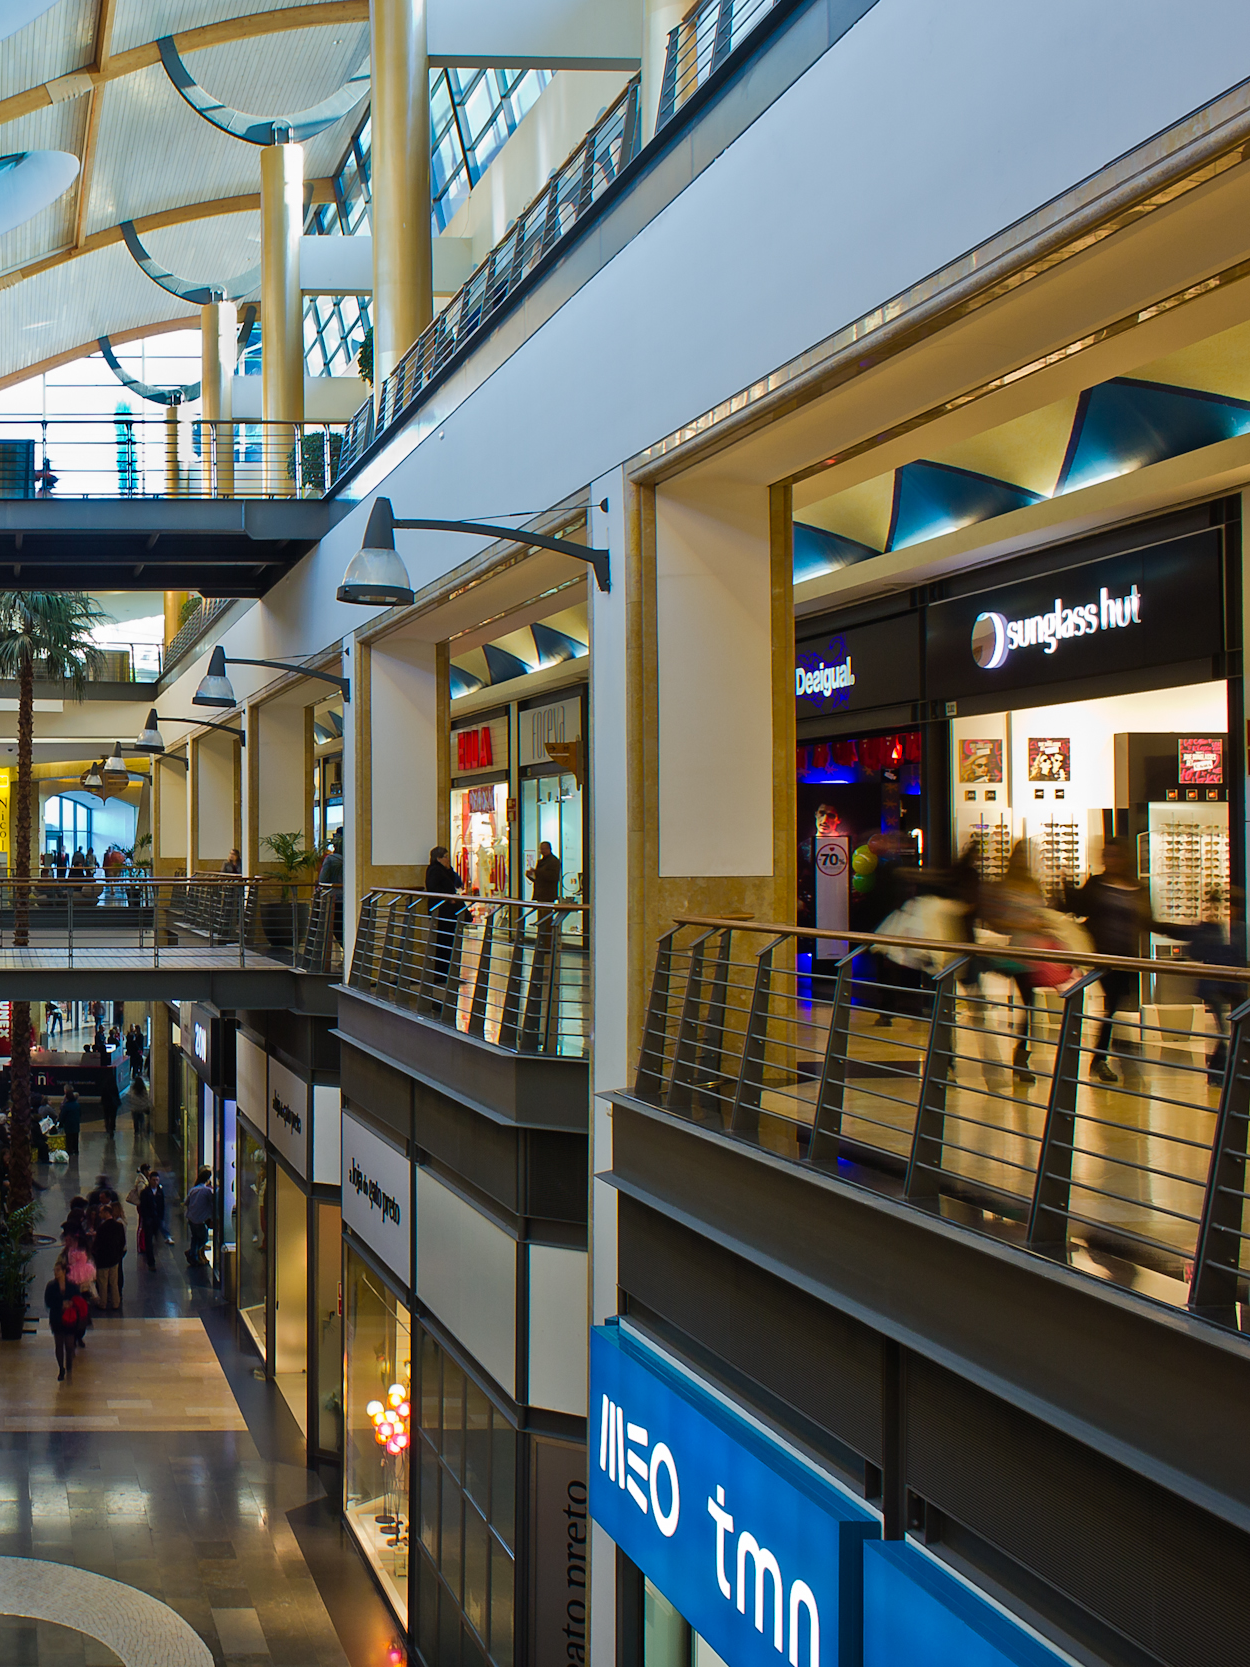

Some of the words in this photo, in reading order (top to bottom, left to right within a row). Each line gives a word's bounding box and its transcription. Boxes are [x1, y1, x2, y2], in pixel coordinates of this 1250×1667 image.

[1007, 598, 1099, 654] sunglass
[1100, 584, 1142, 630] hut
[382, 1191, 401, 1226] preto
[600, 1393, 680, 1537] MEO
[707, 1484, 820, 1667] tmn
